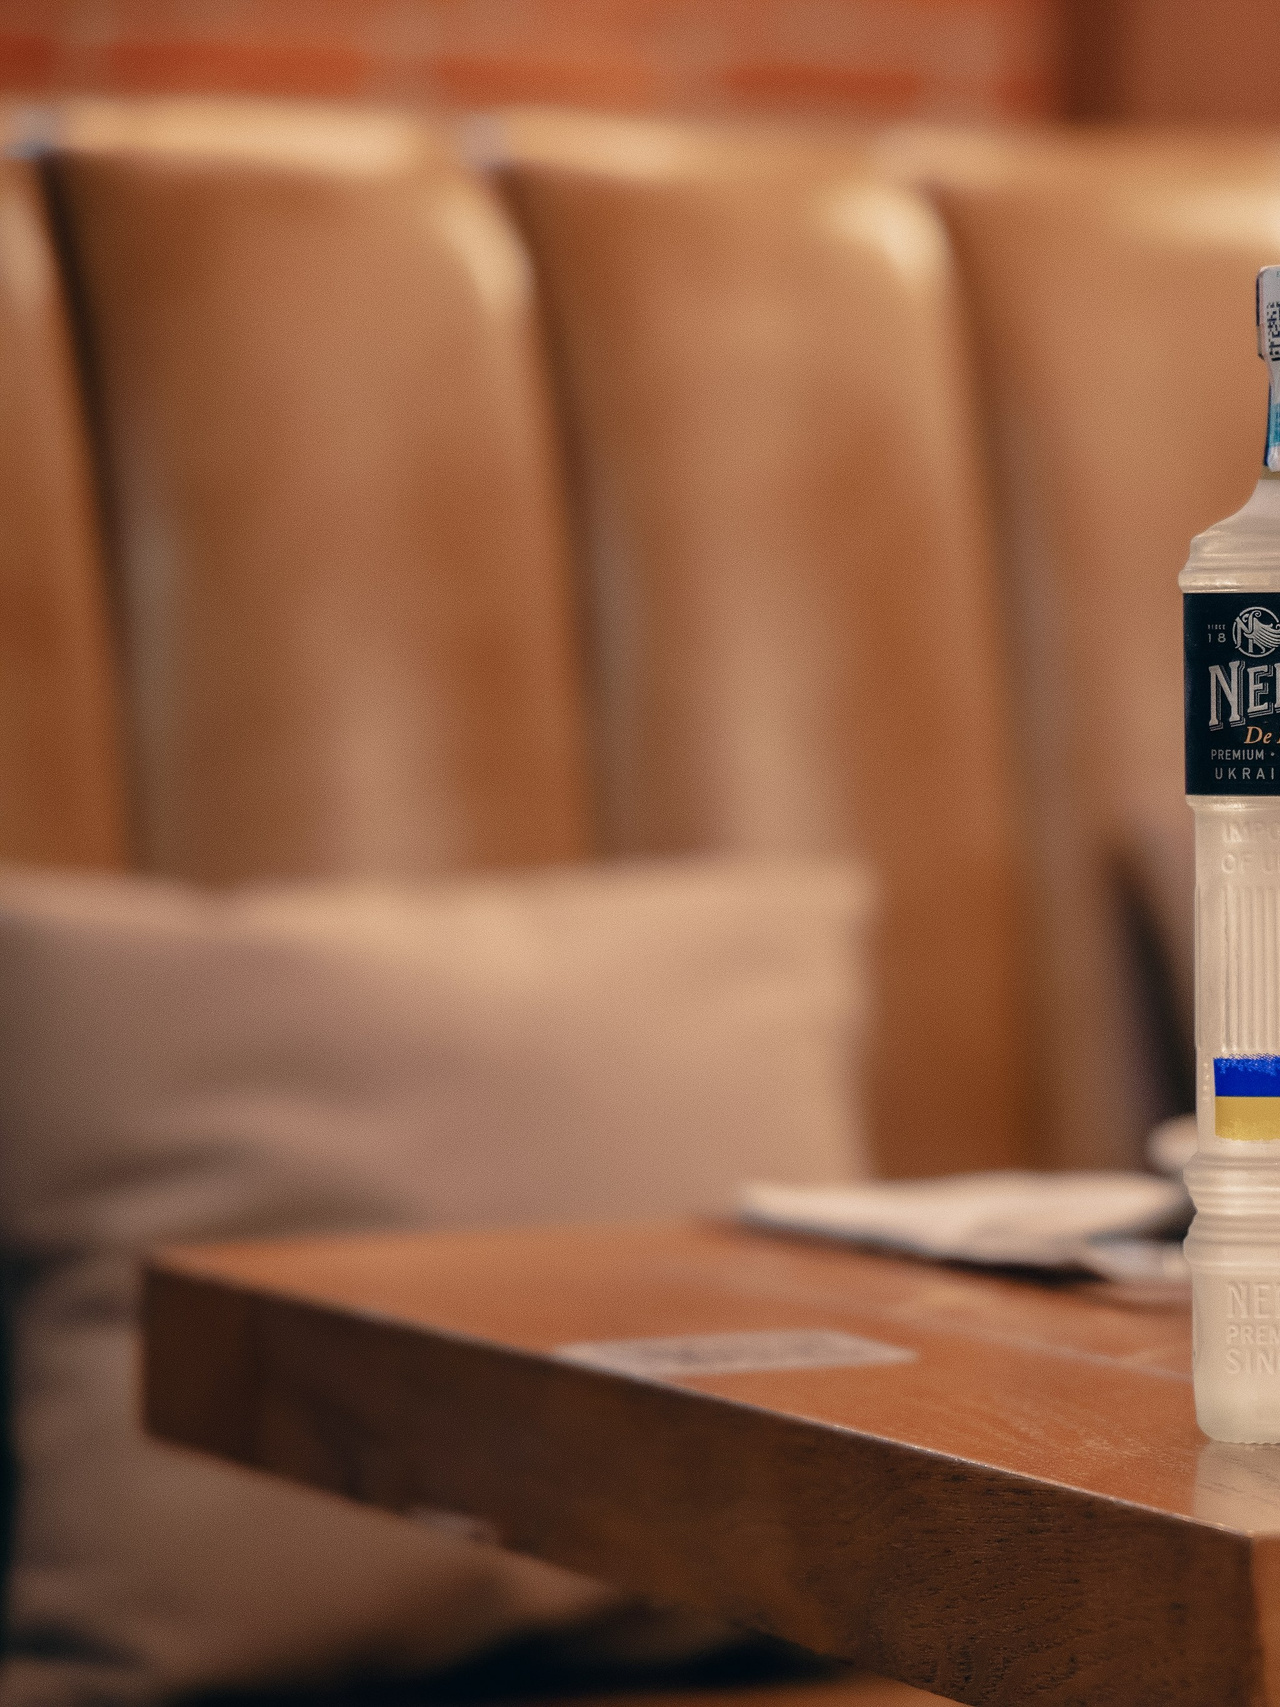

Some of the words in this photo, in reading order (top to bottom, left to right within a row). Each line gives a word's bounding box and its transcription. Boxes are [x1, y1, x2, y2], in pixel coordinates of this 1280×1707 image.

[1243, 726, 1272, 744] De
[1210, 748, 1265, 761] PREMIUM
[1221, 852, 1252, 874] OF
